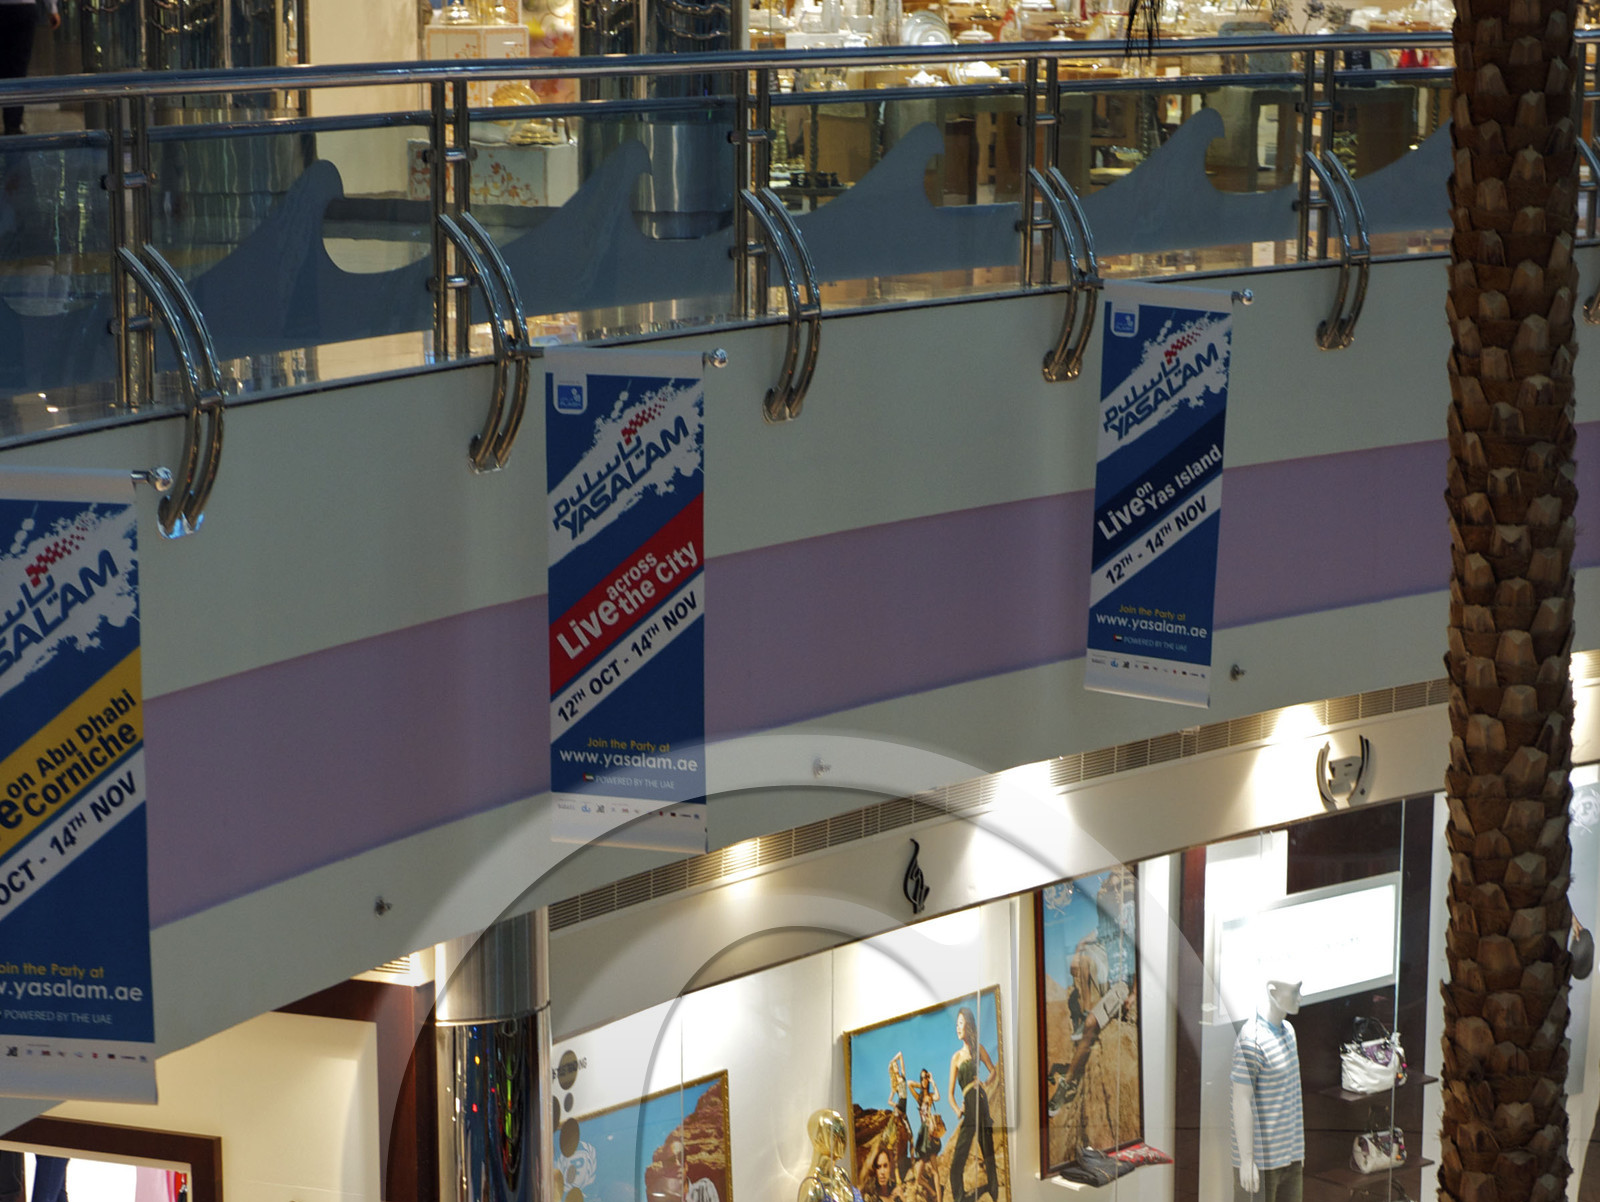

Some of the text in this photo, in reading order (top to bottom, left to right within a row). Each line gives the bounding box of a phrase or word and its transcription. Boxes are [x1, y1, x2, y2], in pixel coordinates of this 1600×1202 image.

[1110, 343, 1219, 440] YASALAM
[560, 416, 689, 540] YASALAM
[1098, 444, 1222, 541] Live Yas Island
[1136, 481, 1153, 498] on
[606, 552, 658, 601] across
[1105, 553, 1133, 585] 12TH
[1145, 523, 1172, 554] 14TH
[1174, 495, 1208, 531] NOV
[0, 549, 118, 677] SALAM
[556, 541, 698, 660] Live the City
[1096, 613, 1207, 639] www.yasalam.ae
[1119, 604, 1186, 621] Join the Party at
[557, 688, 587, 722] 12TH
[589, 659, 621, 695] OCT
[631, 623, 660, 657] 14TH
[661, 591, 698, 631] NOV
[7, 689, 136, 800] on Abu Dhabi
[22, 722, 137, 818] Corniche
[559, 749, 698, 772] www.yasalam.ae
[588, 738, 670, 753] Join the Party at
[595, 775, 632, 787] POWERED
[50, 812, 87, 856] 14TH
[89, 770, 137, 824] NOV
[0, 962, 105, 980] oin the Party at
[4, 1009, 113, 1025] POWERED BY THE UAE
